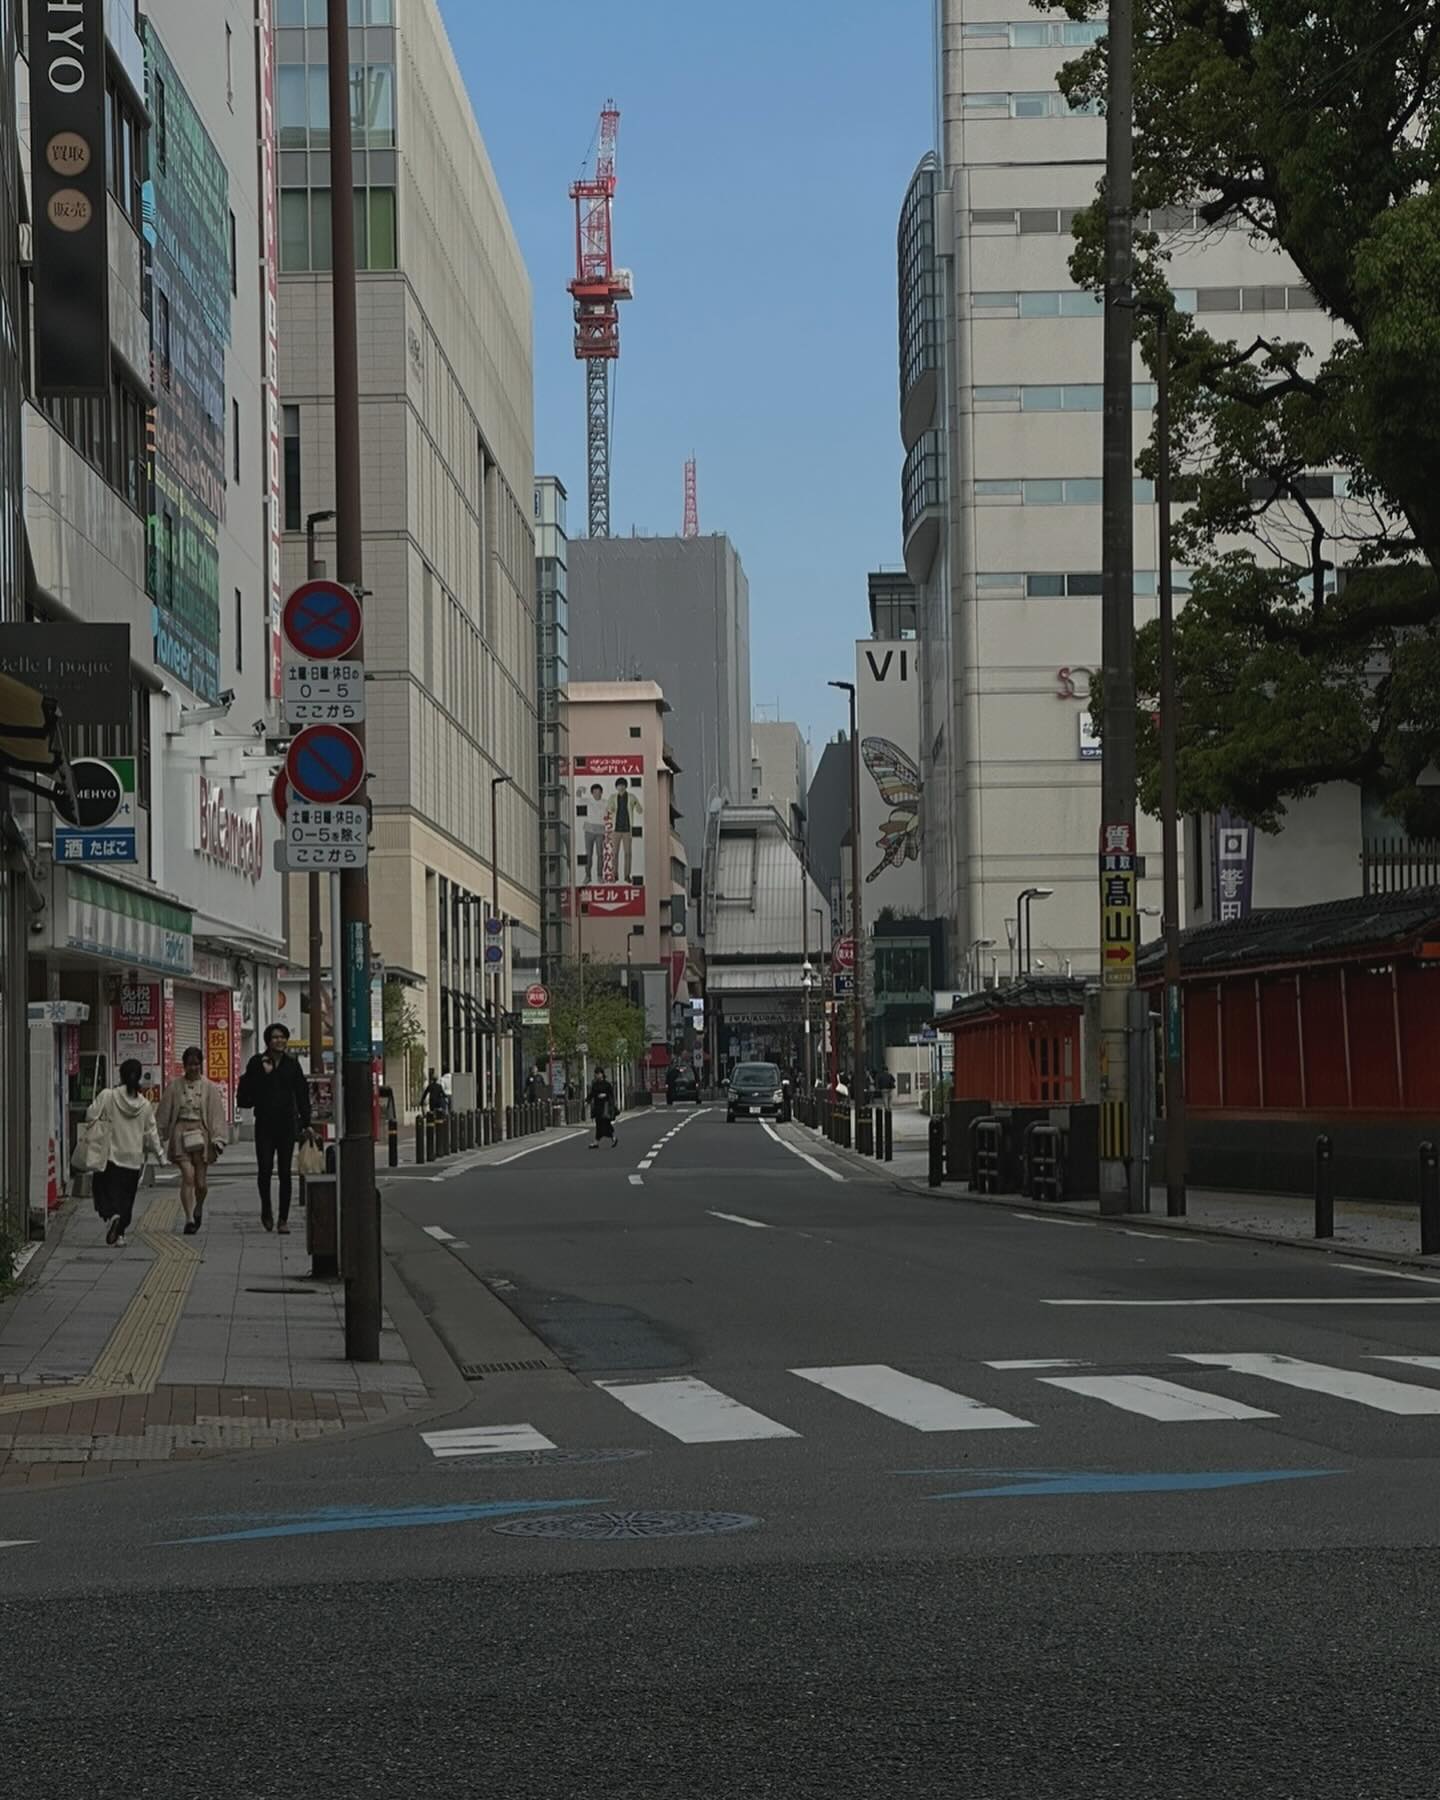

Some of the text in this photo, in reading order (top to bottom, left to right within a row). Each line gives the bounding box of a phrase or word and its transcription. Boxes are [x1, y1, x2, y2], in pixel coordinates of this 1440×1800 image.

[51, 144, 85, 162] 買取
[53, 201, 86, 218] 販売
[865, 650, 918, 681] VI
[296, 705, 355, 718] ここから
[1105, 825, 1130, 852] 質
[64, 839, 128, 858] 酒 たばこ
[297, 849, 357, 862] ここから
[1105, 855, 1131, 870] 買取
[623, 888, 641, 902] 1F
